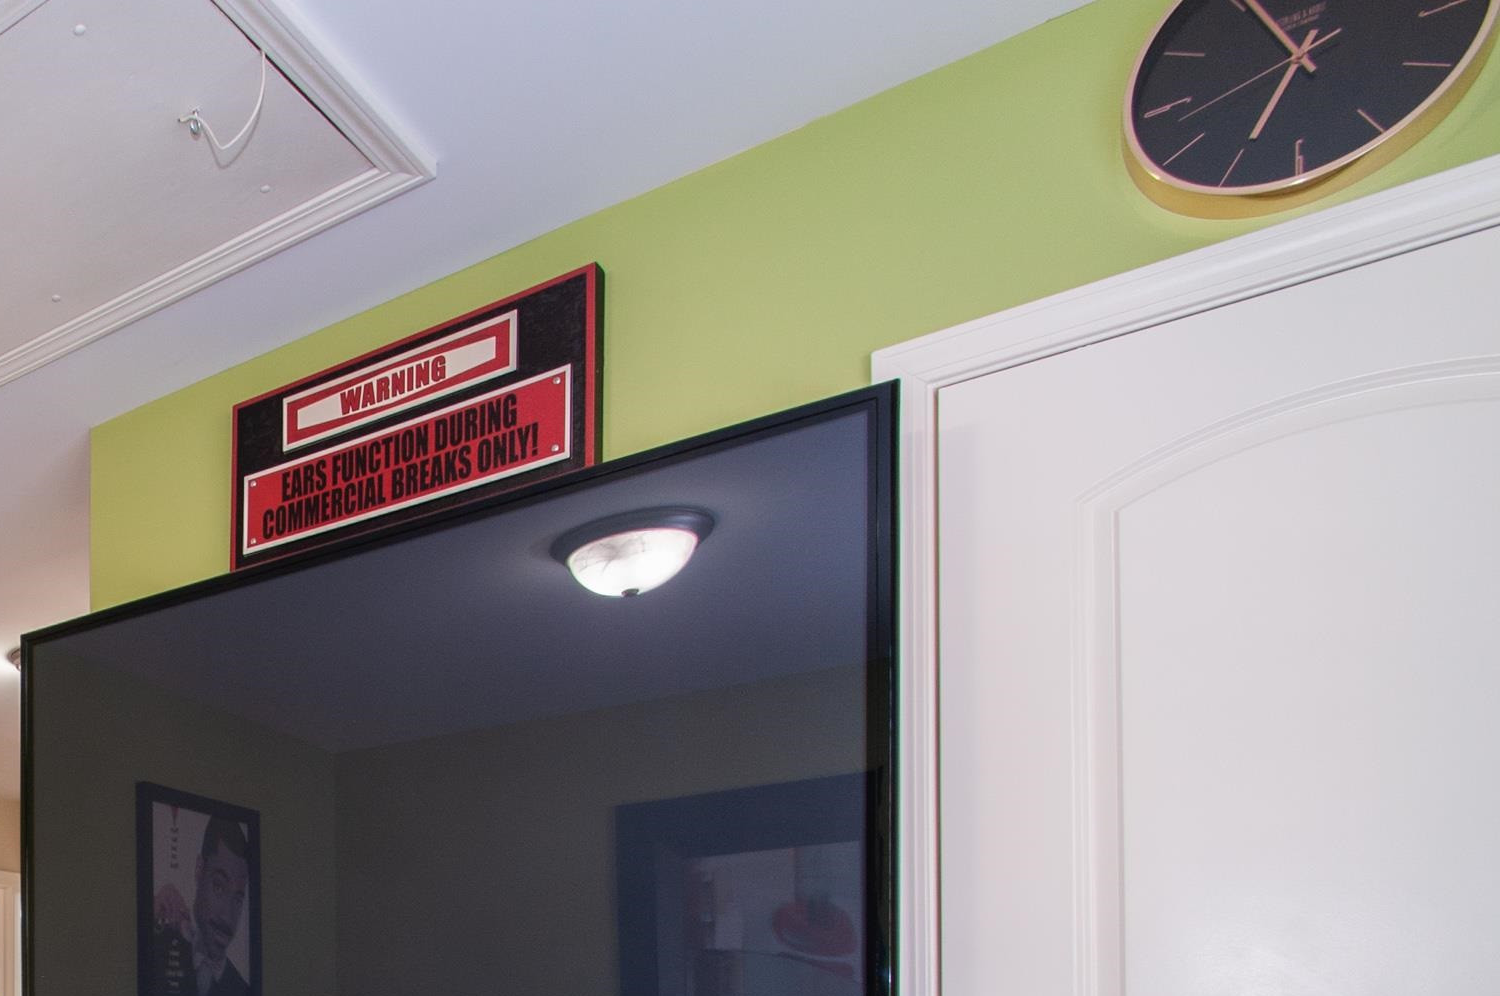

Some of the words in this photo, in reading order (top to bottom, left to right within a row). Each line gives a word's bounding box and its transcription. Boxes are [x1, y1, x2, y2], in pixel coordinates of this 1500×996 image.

[340, 355, 446, 416] WARNING
[262, 484, 386, 540] COMMERCIAL
[391, 450, 471, 502] BREAKS
[477, 422, 539, 473] ONLY!
[281, 466, 328, 503] EARS
[331, 427, 428, 487] FUNCTION
[434, 393, 517, 451] DURING
